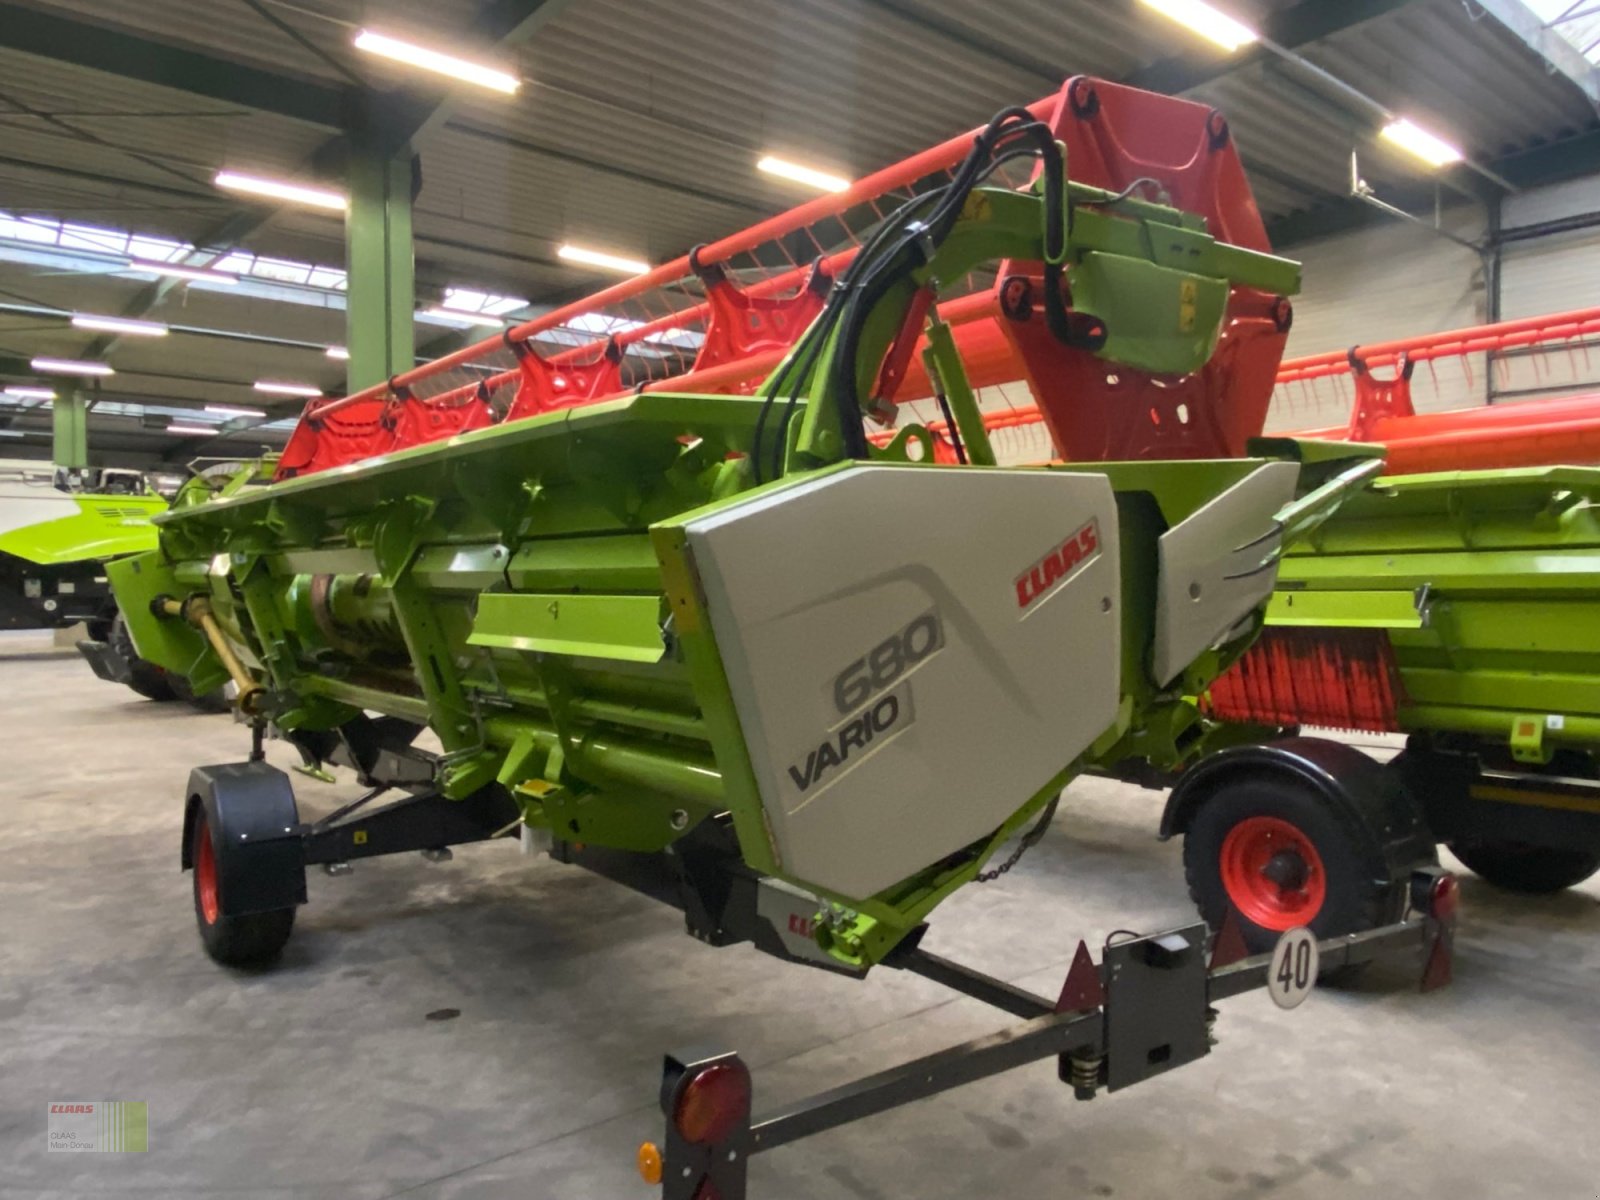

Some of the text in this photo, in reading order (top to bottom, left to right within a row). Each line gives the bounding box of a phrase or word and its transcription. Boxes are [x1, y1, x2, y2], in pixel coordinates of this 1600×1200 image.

[1016, 523, 1097, 608] CLAAS
[834, 614, 938, 715] 680
[788, 695, 899, 792] VARIO
[1277, 938, 1311, 993] 40
